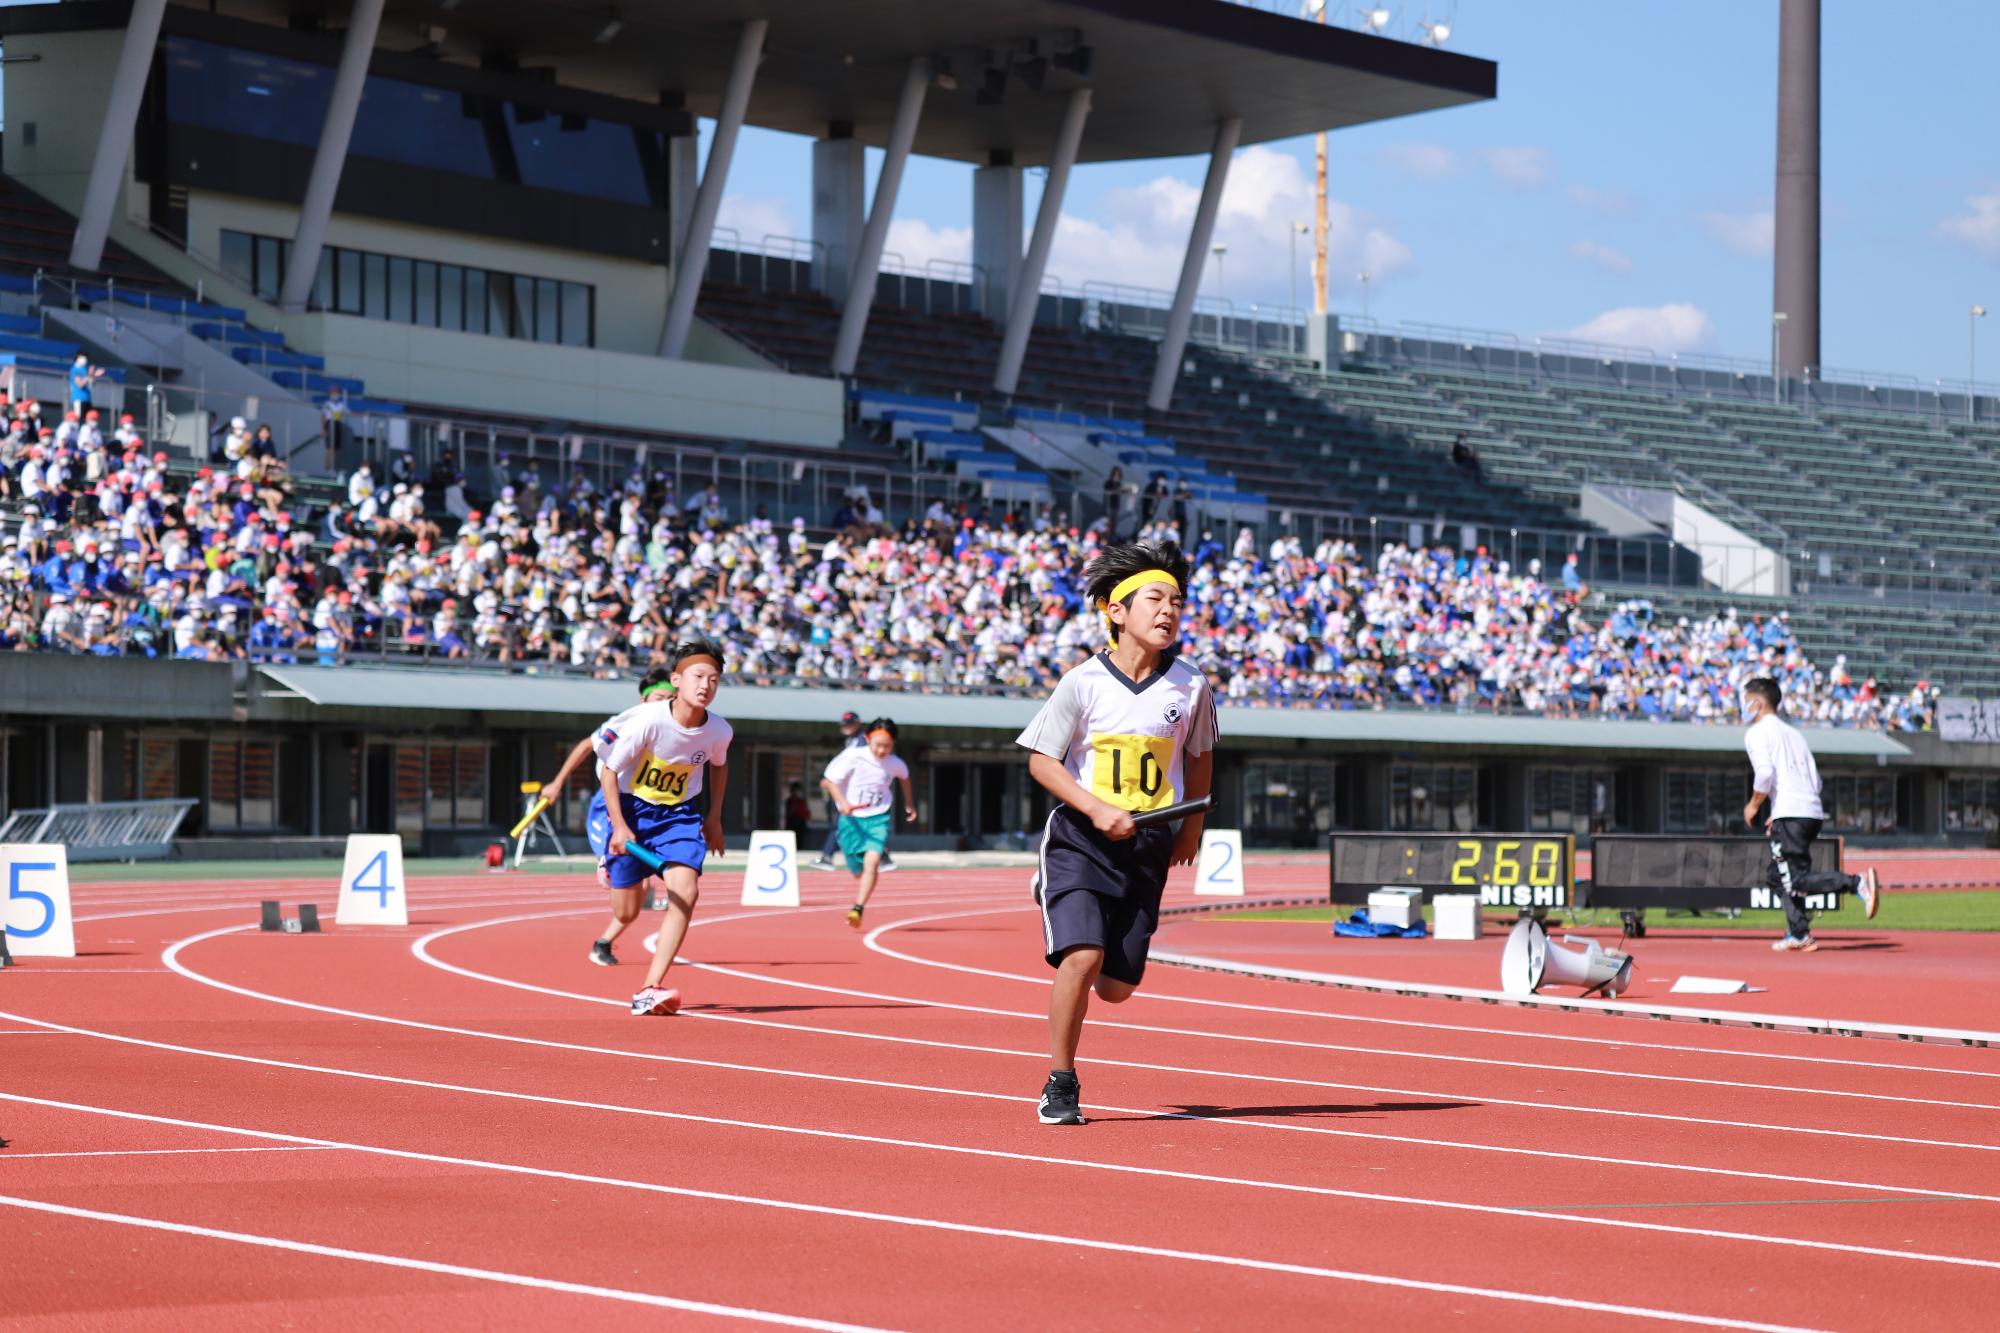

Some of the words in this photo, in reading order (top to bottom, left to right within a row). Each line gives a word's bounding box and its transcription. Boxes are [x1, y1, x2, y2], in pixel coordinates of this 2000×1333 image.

[635, 759, 689, 797] 1009
[1113, 748, 1163, 797] 10
[351, 850, 396, 908] 4
[757, 844, 788, 893] 3
[1208, 841, 1234, 883] 2
[1451, 841, 1559, 886] 2.60
[5, 862, 56, 939] 5
[1481, 884, 1564, 906] NISHI
